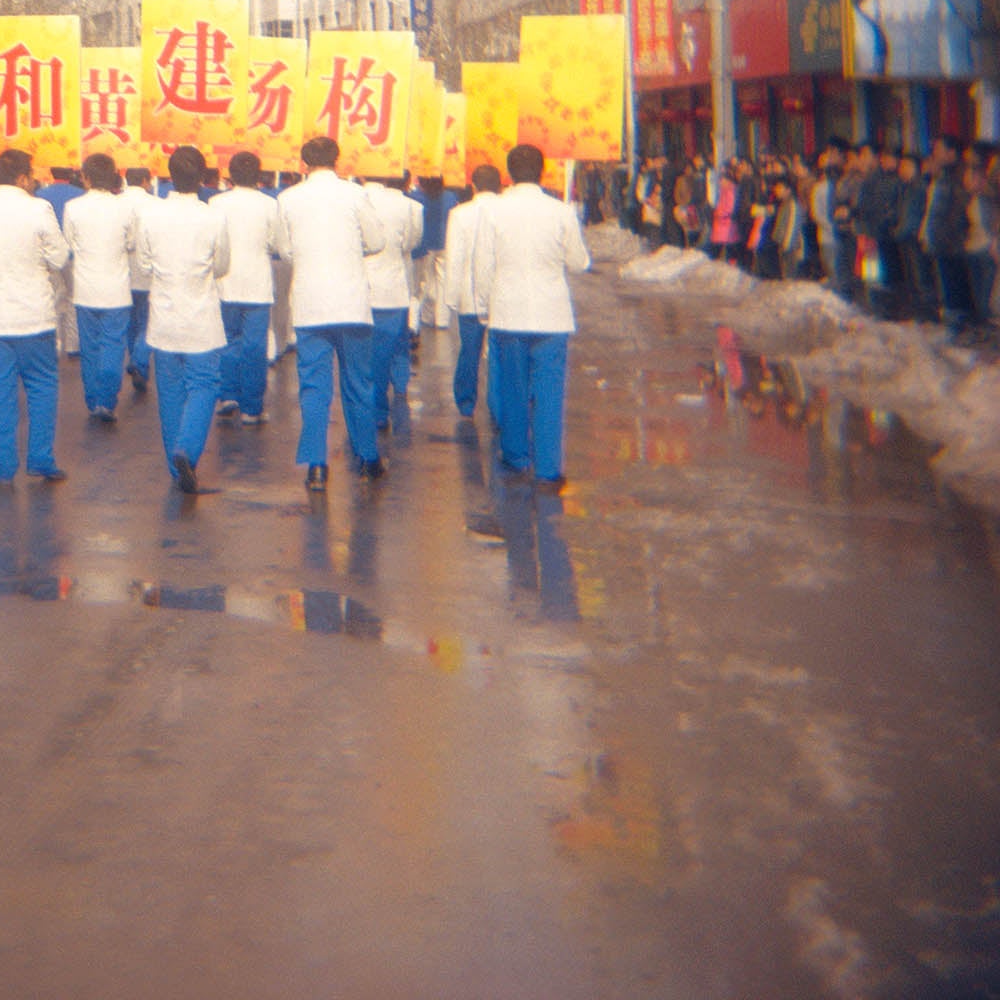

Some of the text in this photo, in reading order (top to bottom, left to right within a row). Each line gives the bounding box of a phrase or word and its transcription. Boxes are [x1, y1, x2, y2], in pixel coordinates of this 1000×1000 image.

[81, 68, 138, 144] 黄
[155, 21, 235, 114] 建
[318, 56, 398, 147] 构
